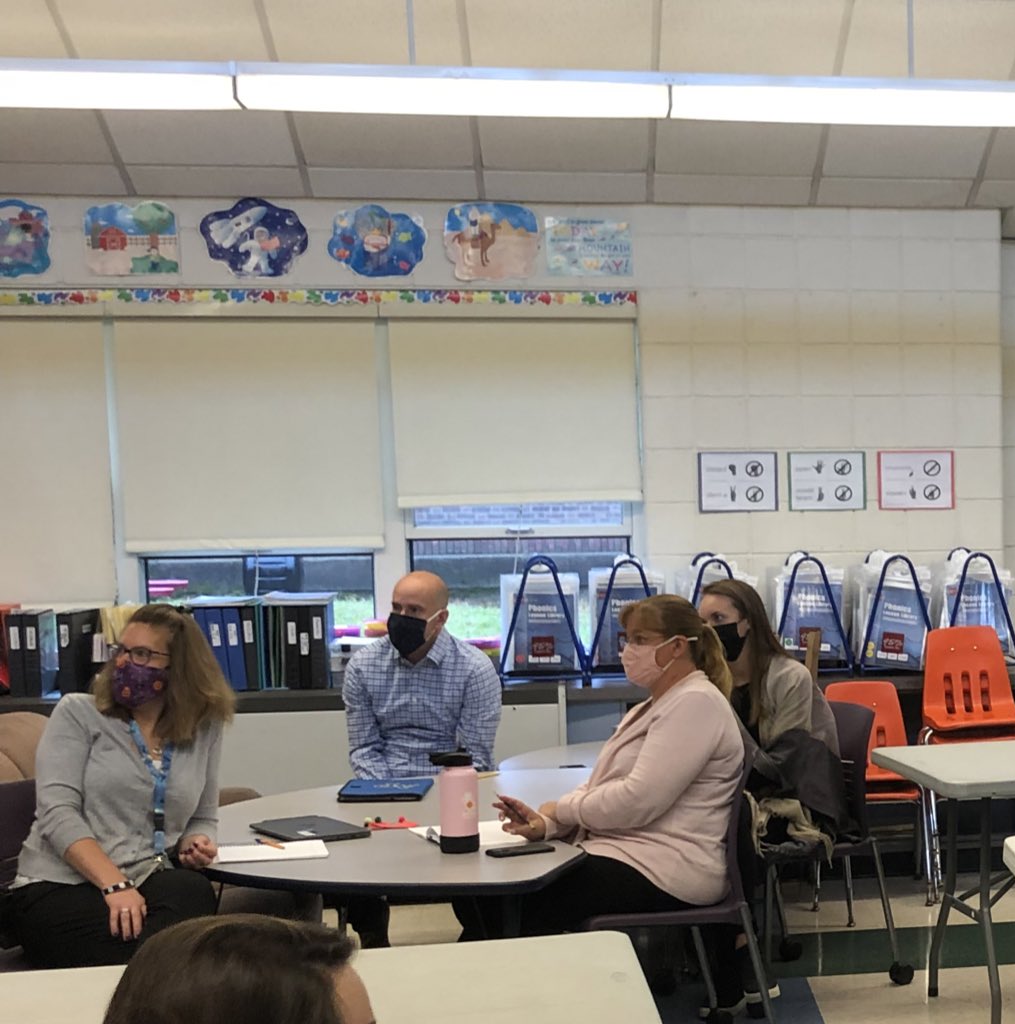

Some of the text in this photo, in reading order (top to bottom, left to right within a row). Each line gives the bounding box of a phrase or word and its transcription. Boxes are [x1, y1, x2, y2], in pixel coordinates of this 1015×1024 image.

[584, 258, 630, 273] WAY!
[528, 603, 557, 613] Phonics
[884, 602, 912, 613] Phonics
